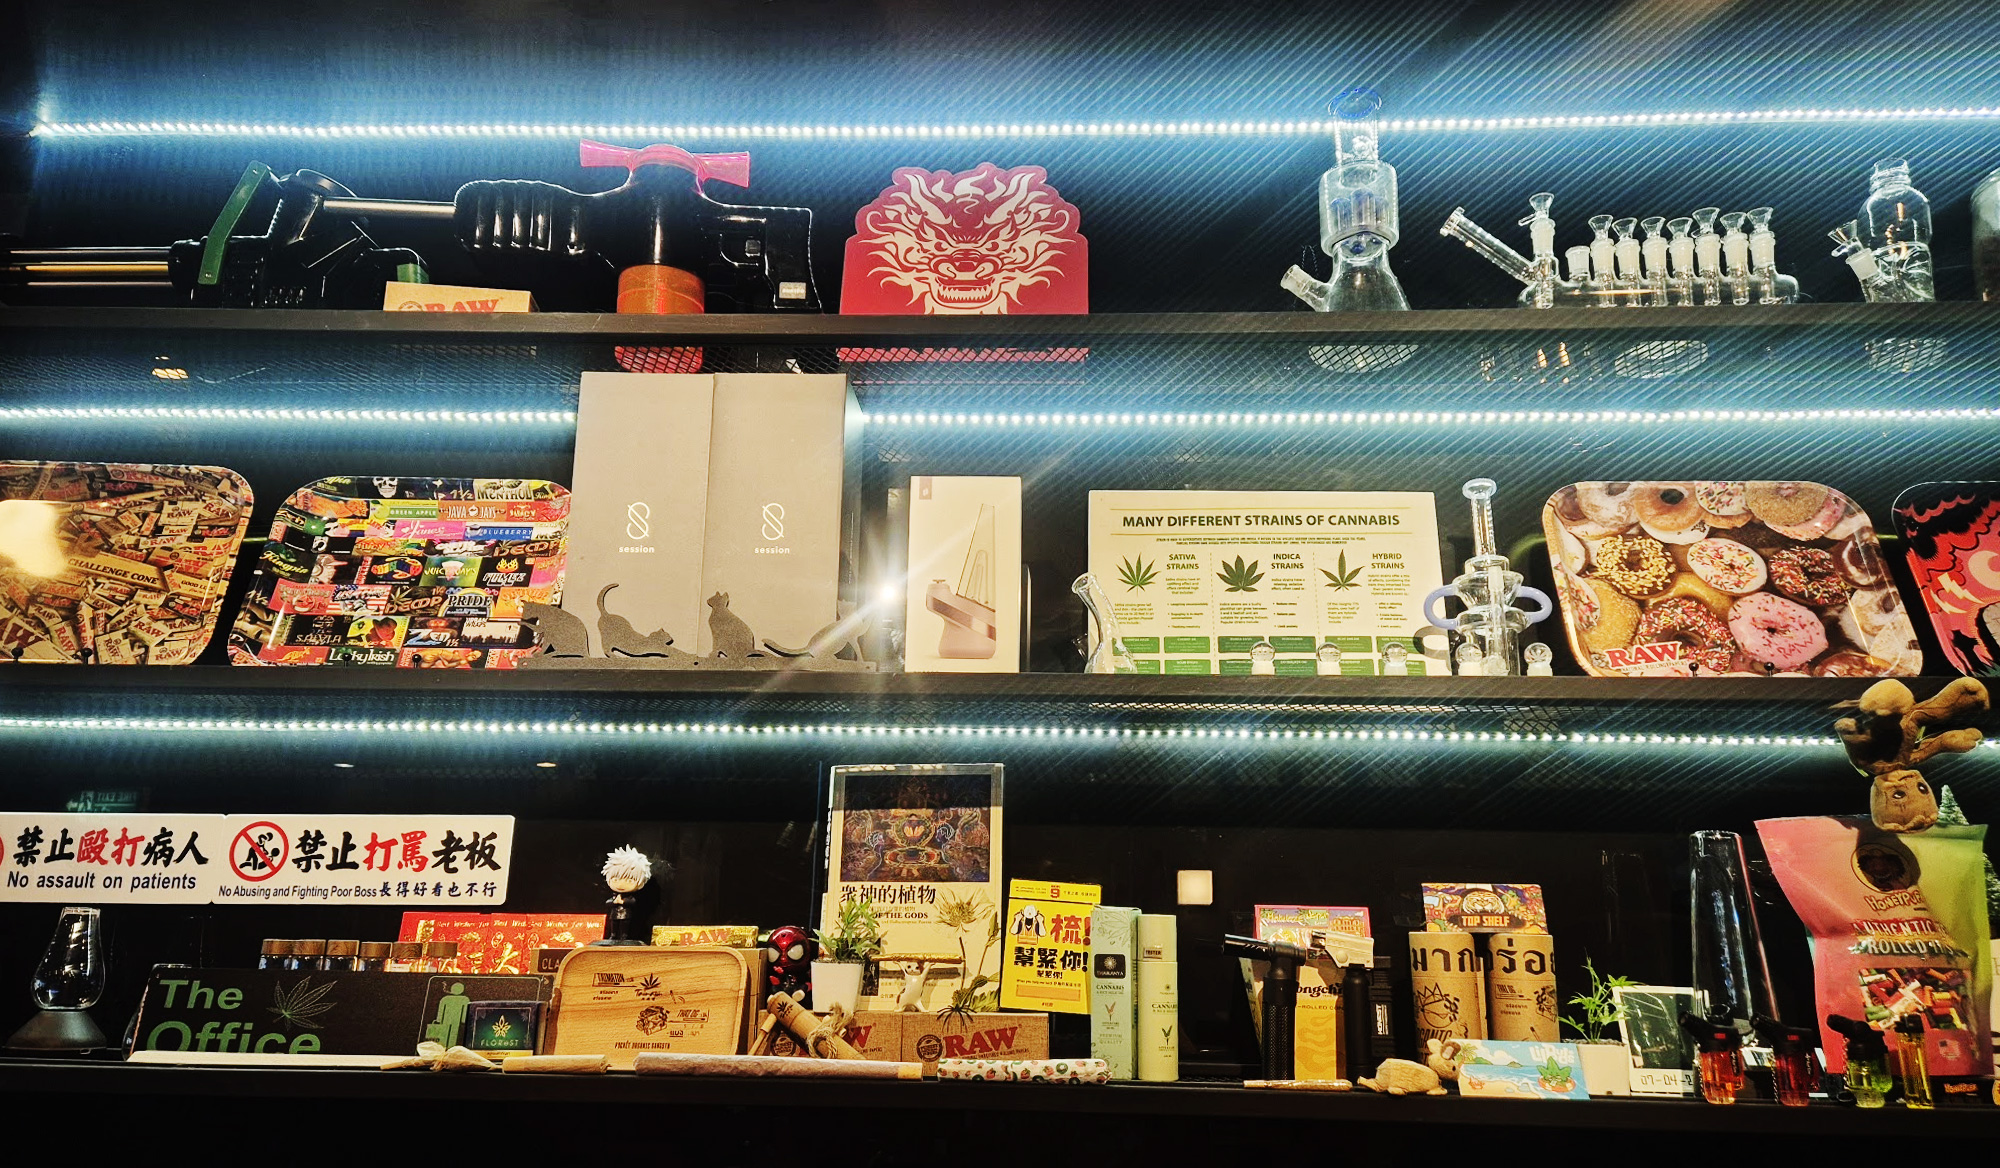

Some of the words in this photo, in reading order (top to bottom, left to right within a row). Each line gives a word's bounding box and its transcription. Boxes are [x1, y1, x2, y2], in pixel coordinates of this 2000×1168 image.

[167, 509, 193, 518] RAW
[446, 505, 467, 518] JAVA
[480, 505, 496, 518] JAYS
[1122, 516, 1164, 528] MANY
[1167, 515, 1241, 527] DIFFERENT
[1244, 514, 1303, 526] STRAINS
[1306, 514, 1325, 526] OF
[1328, 514, 1400, 526] CANNABIS
[150, 536, 177, 546] RAW
[618, 545, 655, 554] session
[754, 546, 790, 554] session
[68, 558, 130, 578] CHALLENGE
[130, 572, 160, 584] CONE
[1166, 562, 1200, 570] STRAINS
[93, 600, 112, 612] RAW
[448, 594, 494, 607] PRIDE
[134, 618, 164, 638] RAW
[54, 626, 77, 652] RAW
[104, 638, 120, 658] RAW
[156, 647, 182, 660] RAW
[368, 648, 395, 662] Irish
[1606, 642, 1680, 668] RAW
[12, 825, 210, 868] 禁止毆打病人
[292, 830, 502, 874] 禁止打罵老板
[7, 870, 28, 888] No
[36, 872, 96, 889] assault
[102, 876, 123, 890] on
[130, 872, 197, 892] patients
[218, 885, 232, 896] No
[234, 886, 268, 900] Abusing
[272, 886, 290, 898] and
[292, 886, 329, 900] Fighting
[330, 886, 352, 898] Poor
[354, 886, 378, 898] Boss
[378, 881, 498, 898] 長得好看也不行
[1050, 888, 1060, 898] 9
[1462, 916, 1480, 927] TOP
[1482, 916, 1510, 927] SHELF
[680, 928, 730, 946] RAW
[1867, 940, 1928, 954] ROLLED
[158, 979, 244, 1010] The
[146, 1020, 322, 1054] Office
[942, 1026, 1019, 1058] RAW
